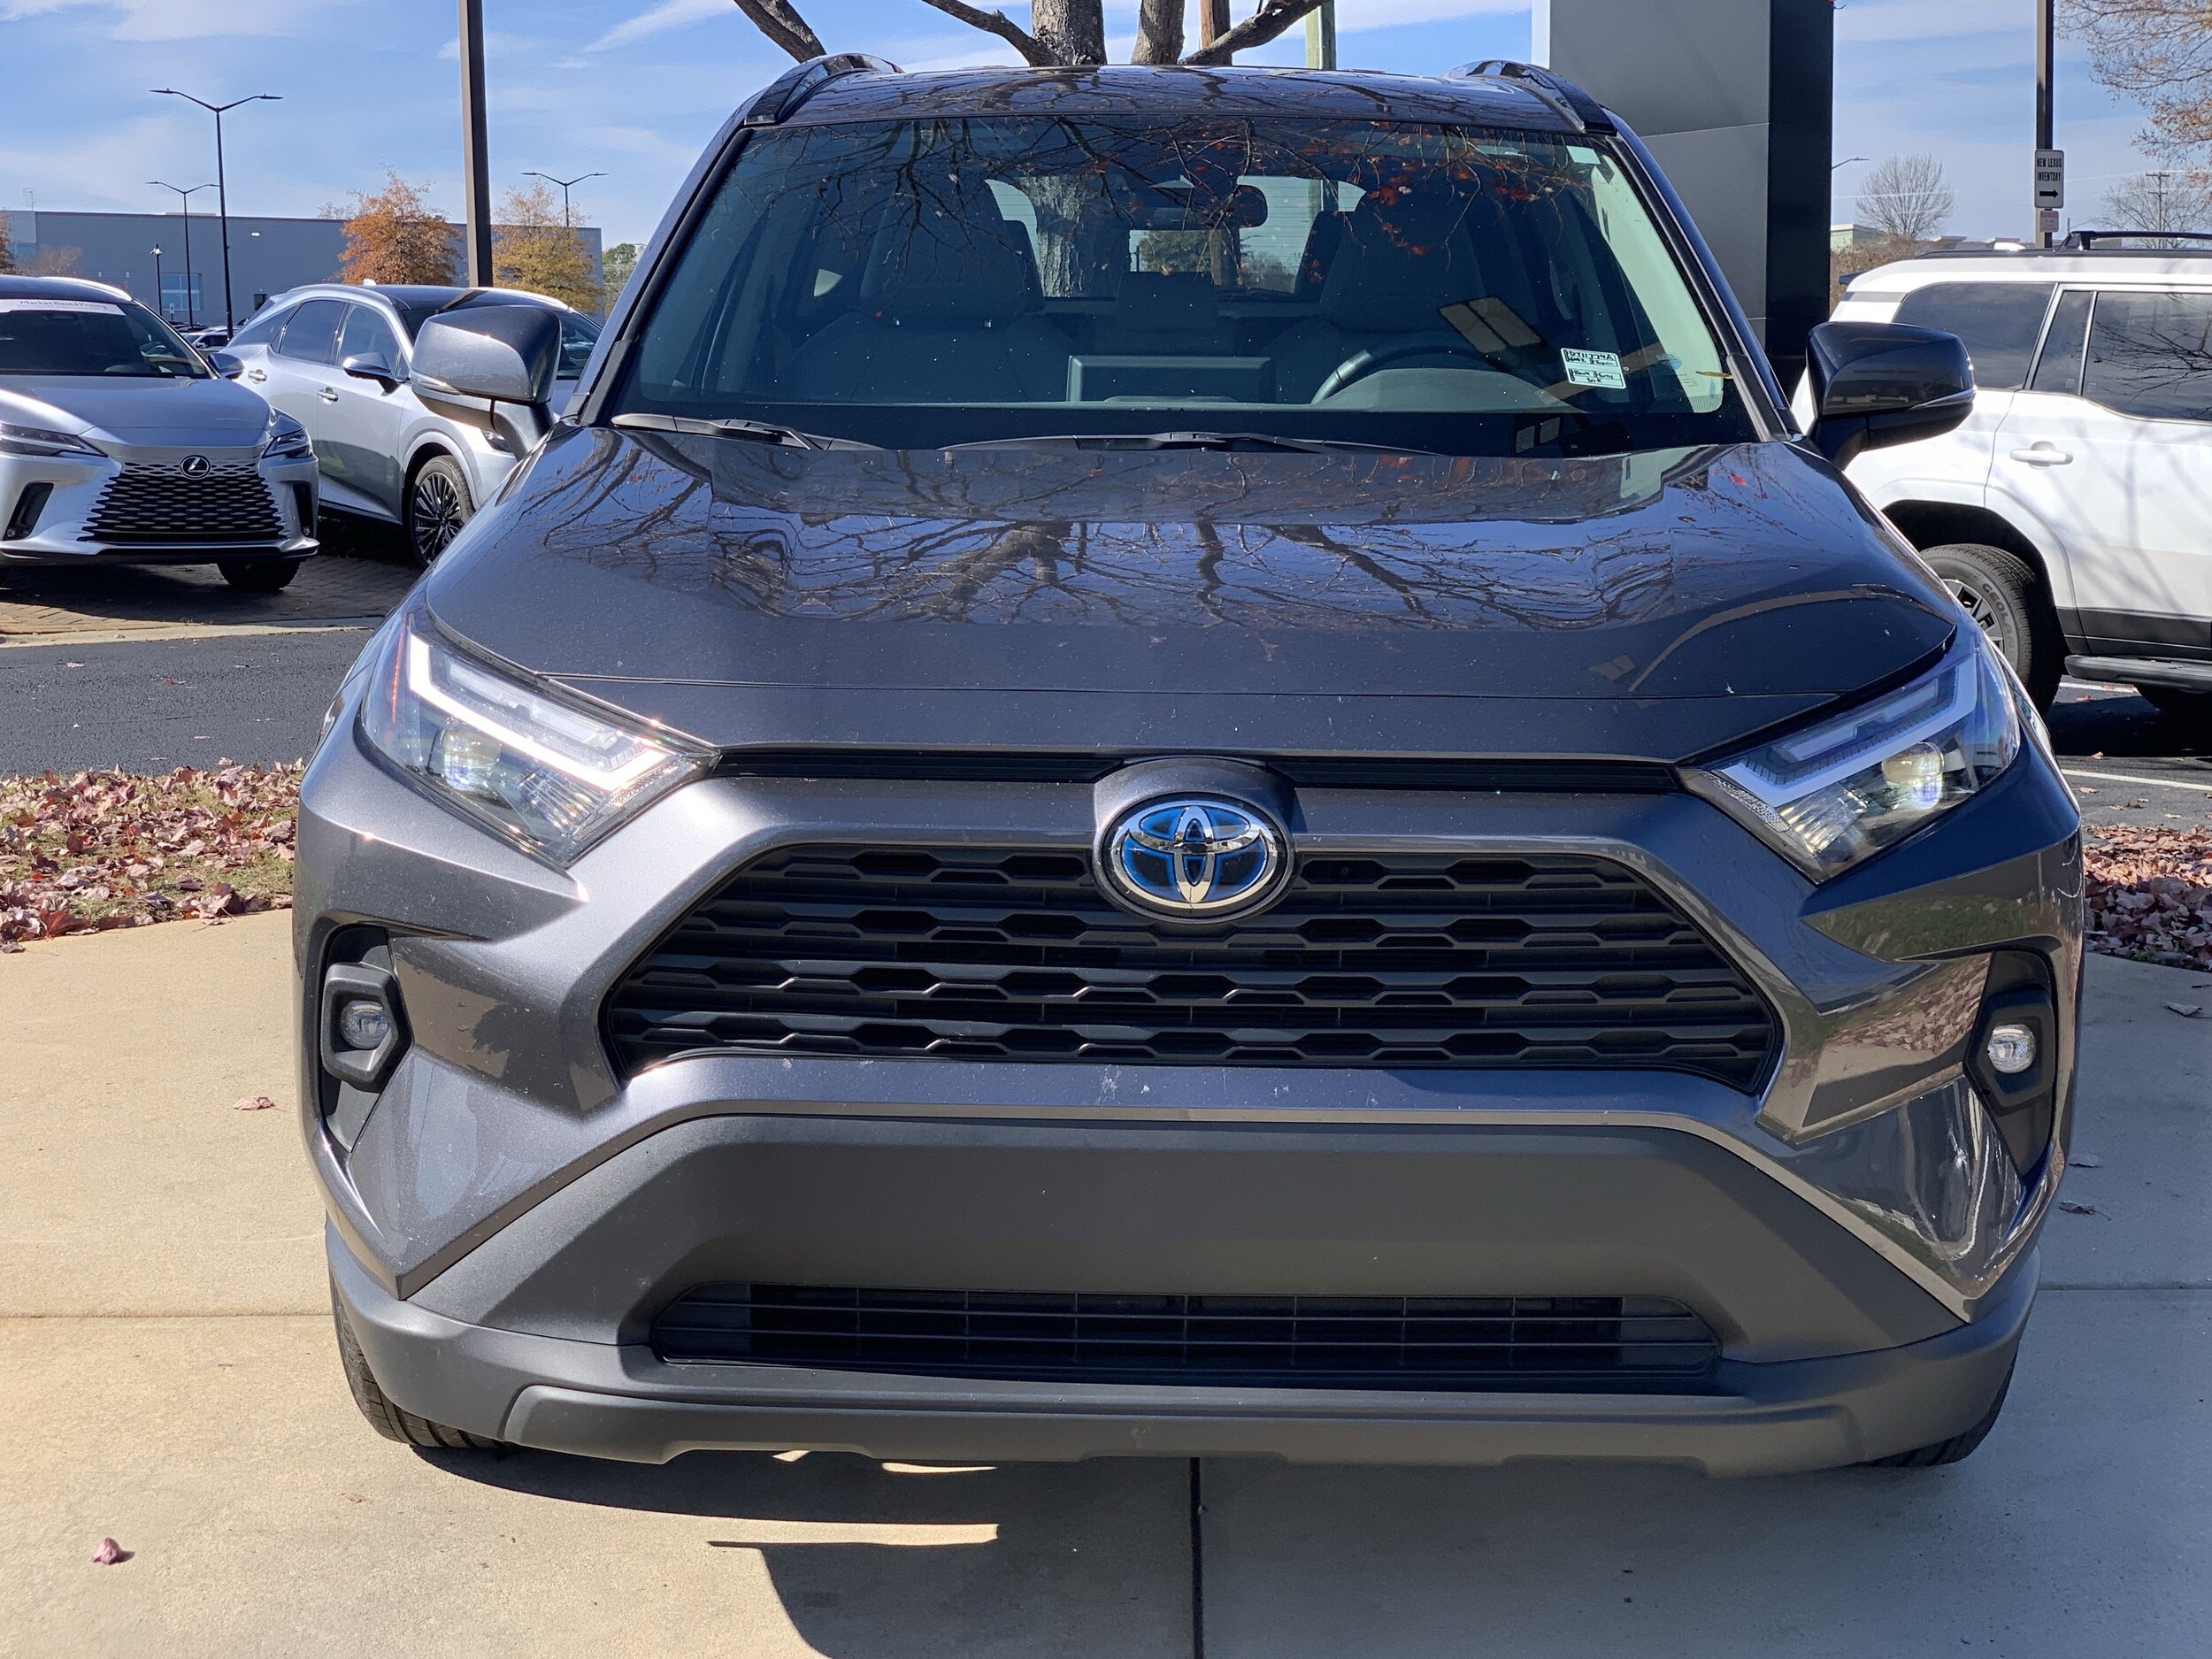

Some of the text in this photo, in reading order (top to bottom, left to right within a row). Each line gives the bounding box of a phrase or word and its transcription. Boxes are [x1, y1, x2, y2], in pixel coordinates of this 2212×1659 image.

[2037, 157, 2062, 168] NEW LEXUS
[2037, 172, 2061, 181] INVENTORY
